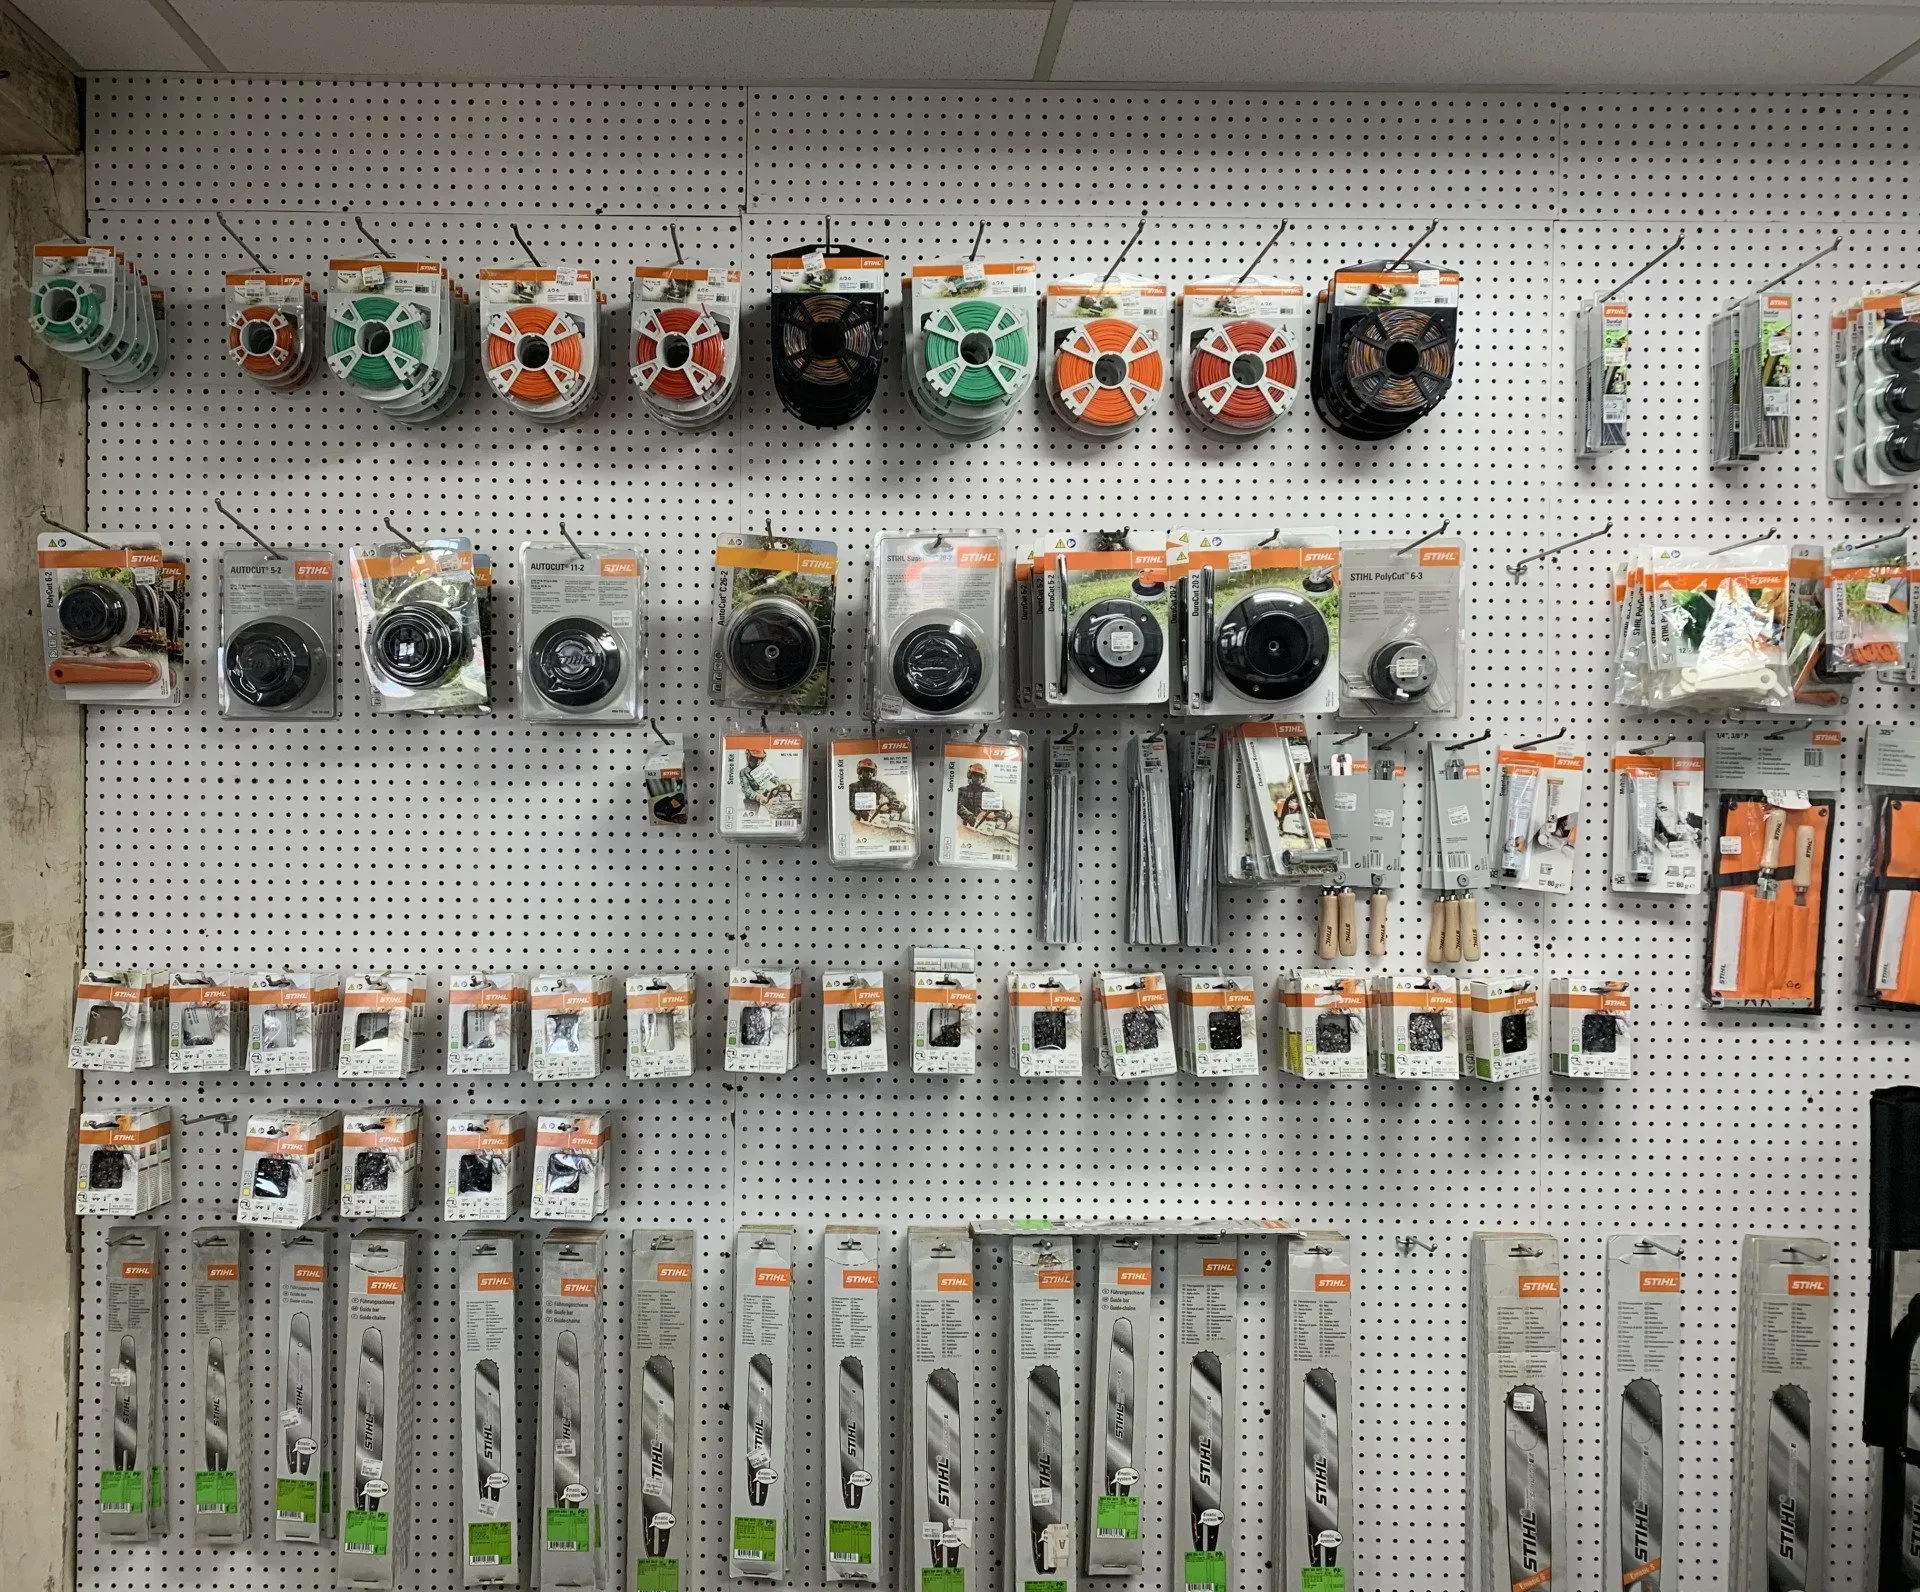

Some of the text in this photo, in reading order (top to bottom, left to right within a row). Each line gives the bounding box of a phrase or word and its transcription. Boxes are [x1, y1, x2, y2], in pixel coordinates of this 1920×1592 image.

[961, 552, 996, 561] STIHL
[1304, 552, 1334, 560] STIHL
[1422, 552, 1456, 560] STIHL
[603, 563, 632, 573] STIHL
[801, 559, 833, 568] STIHL
[846, 1275, 873, 1283] STIHL
[1043, 1275, 1070, 1284] STIHL
[1121, 1272, 1146, 1280] STIHL
[480, 1278, 508, 1286] STIHL
[941, 1279, 968, 1287] STIHL
[1523, 1282, 1556, 1291] STIHL
[1643, 1277, 1674, 1287] STIHL
[1792, 1280, 1824, 1290] STIHL
[122, 1396, 130, 1425] STIHL
[1115, 1404, 1124, 1438] STIHL
[365, 1414, 374, 1450] STIHL
[484, 1424, 493, 1459] STIHL
[848, 1421, 856, 1457] STIHL
[1200, 1438, 1211, 1486] STIHL
[1040, 1455, 1051, 1489] TIHL
[938, 1458, 950, 1506] STIHL
[1316, 1457, 1327, 1506] STIHL
[1635, 1505, 1648, 1562] STIHL
[1779, 1499, 1795, 1560] STIHL
[1523, 1514, 1537, 1572] STIHL
